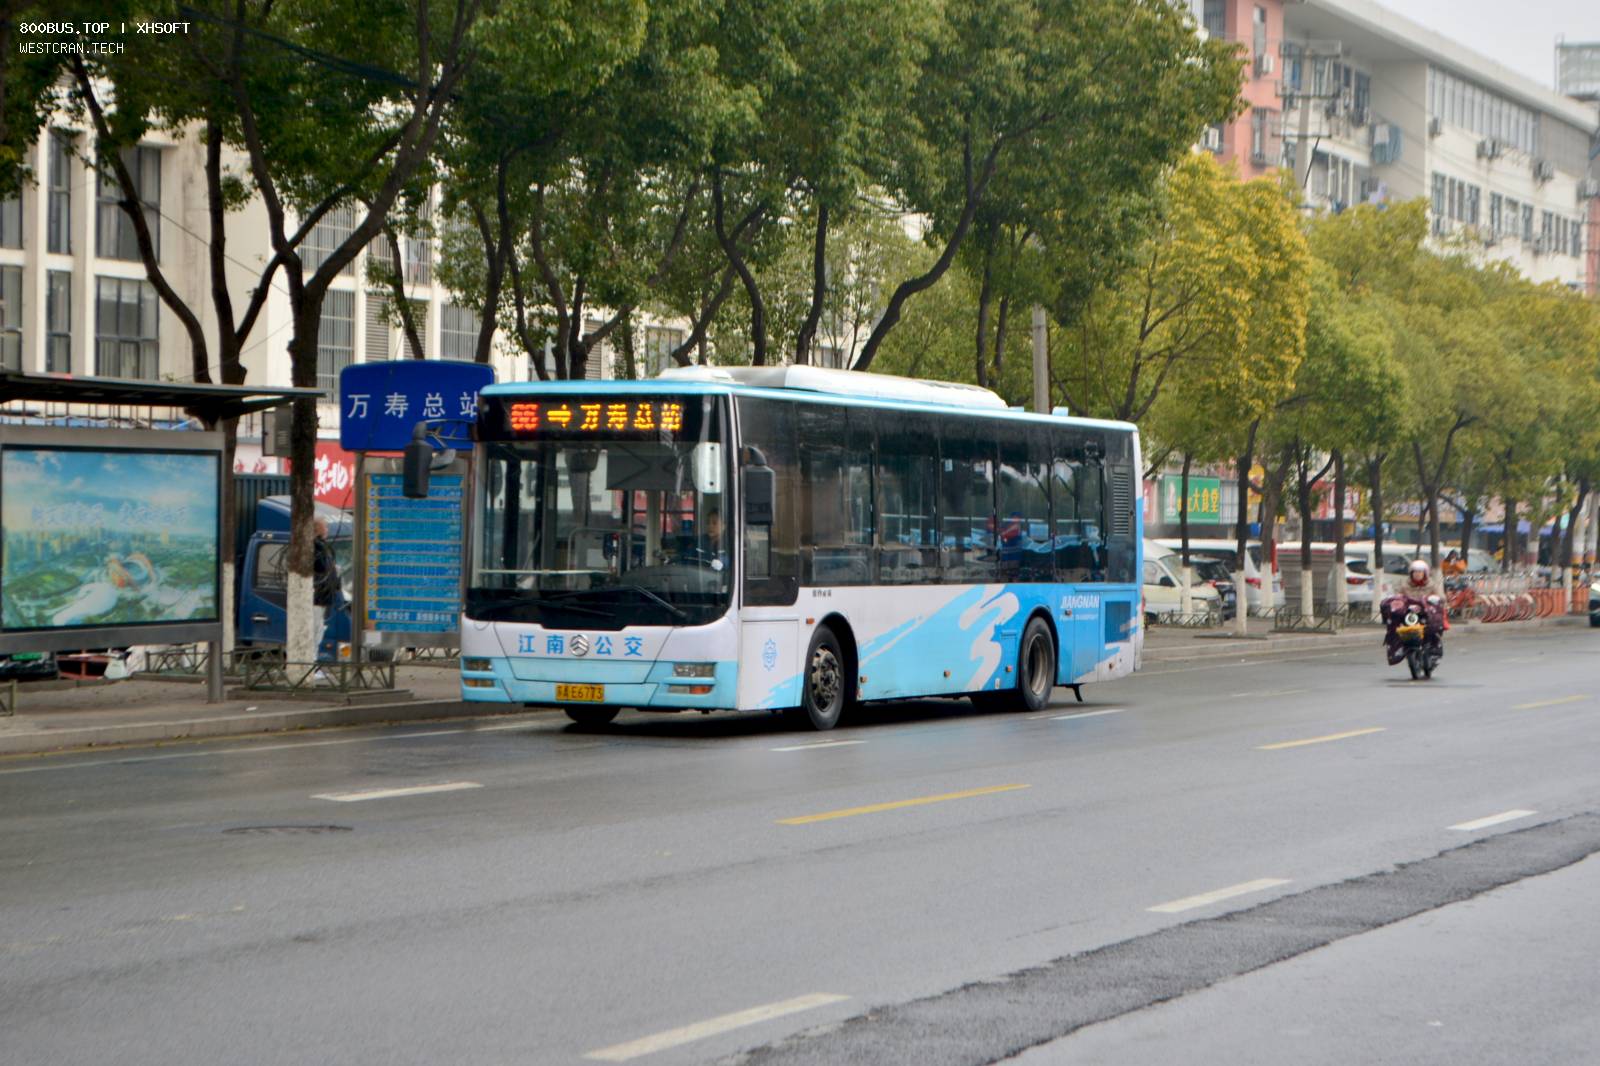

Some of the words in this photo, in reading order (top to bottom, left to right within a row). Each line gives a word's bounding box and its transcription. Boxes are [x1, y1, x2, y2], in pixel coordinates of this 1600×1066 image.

[347, 391, 478, 419] 万寿总站
[1060, 594, 1100, 609] JIANGNAN
[518, 634, 643, 657] 江南公交
